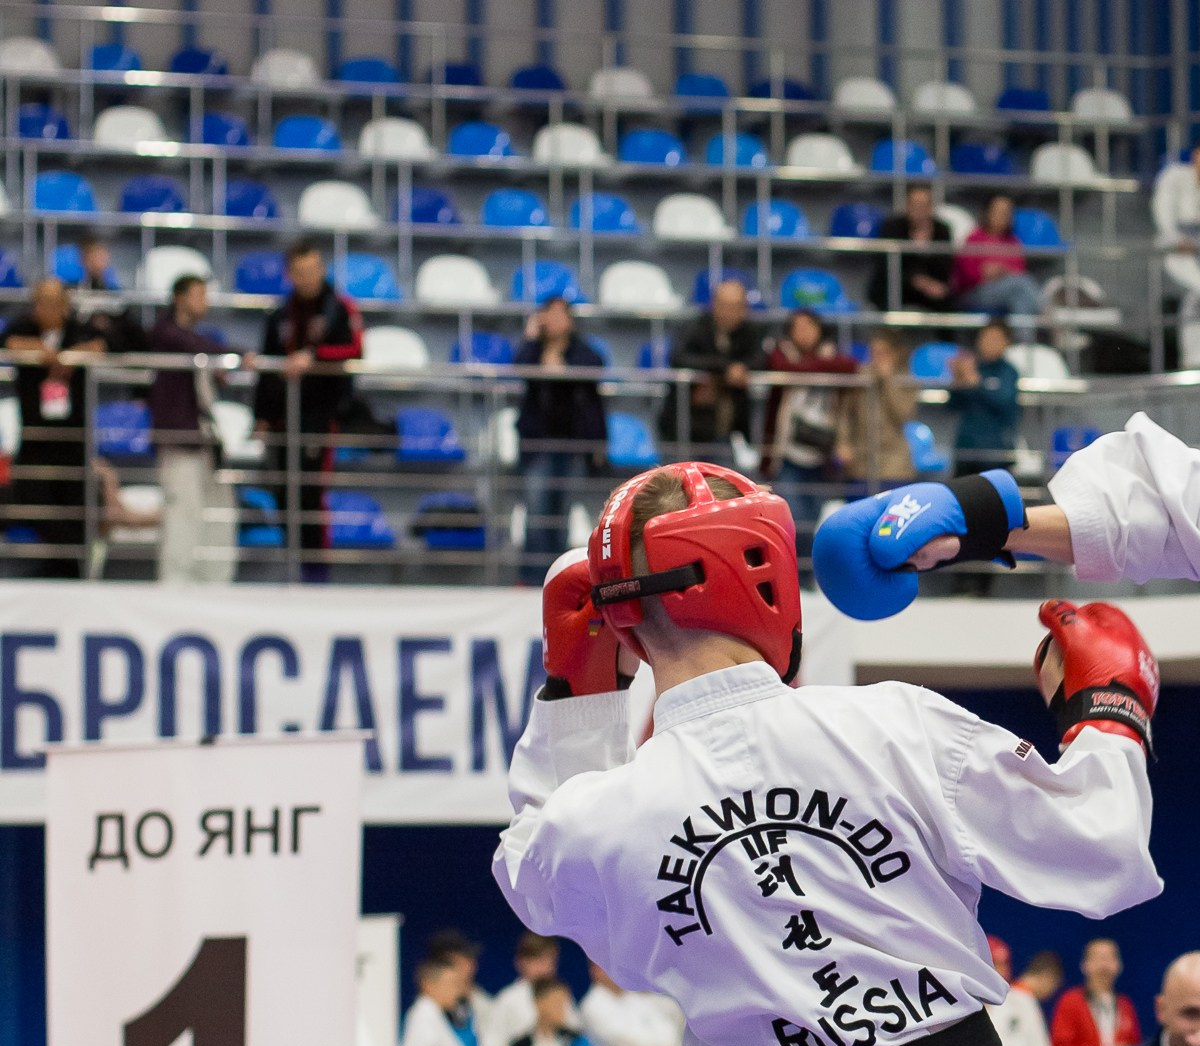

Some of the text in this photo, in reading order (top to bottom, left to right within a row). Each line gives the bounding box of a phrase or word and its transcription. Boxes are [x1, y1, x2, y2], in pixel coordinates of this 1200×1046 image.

[88, 806, 322, 871] ДО ЯНГ
[656, 787, 911, 946] TAEKWON-DO
